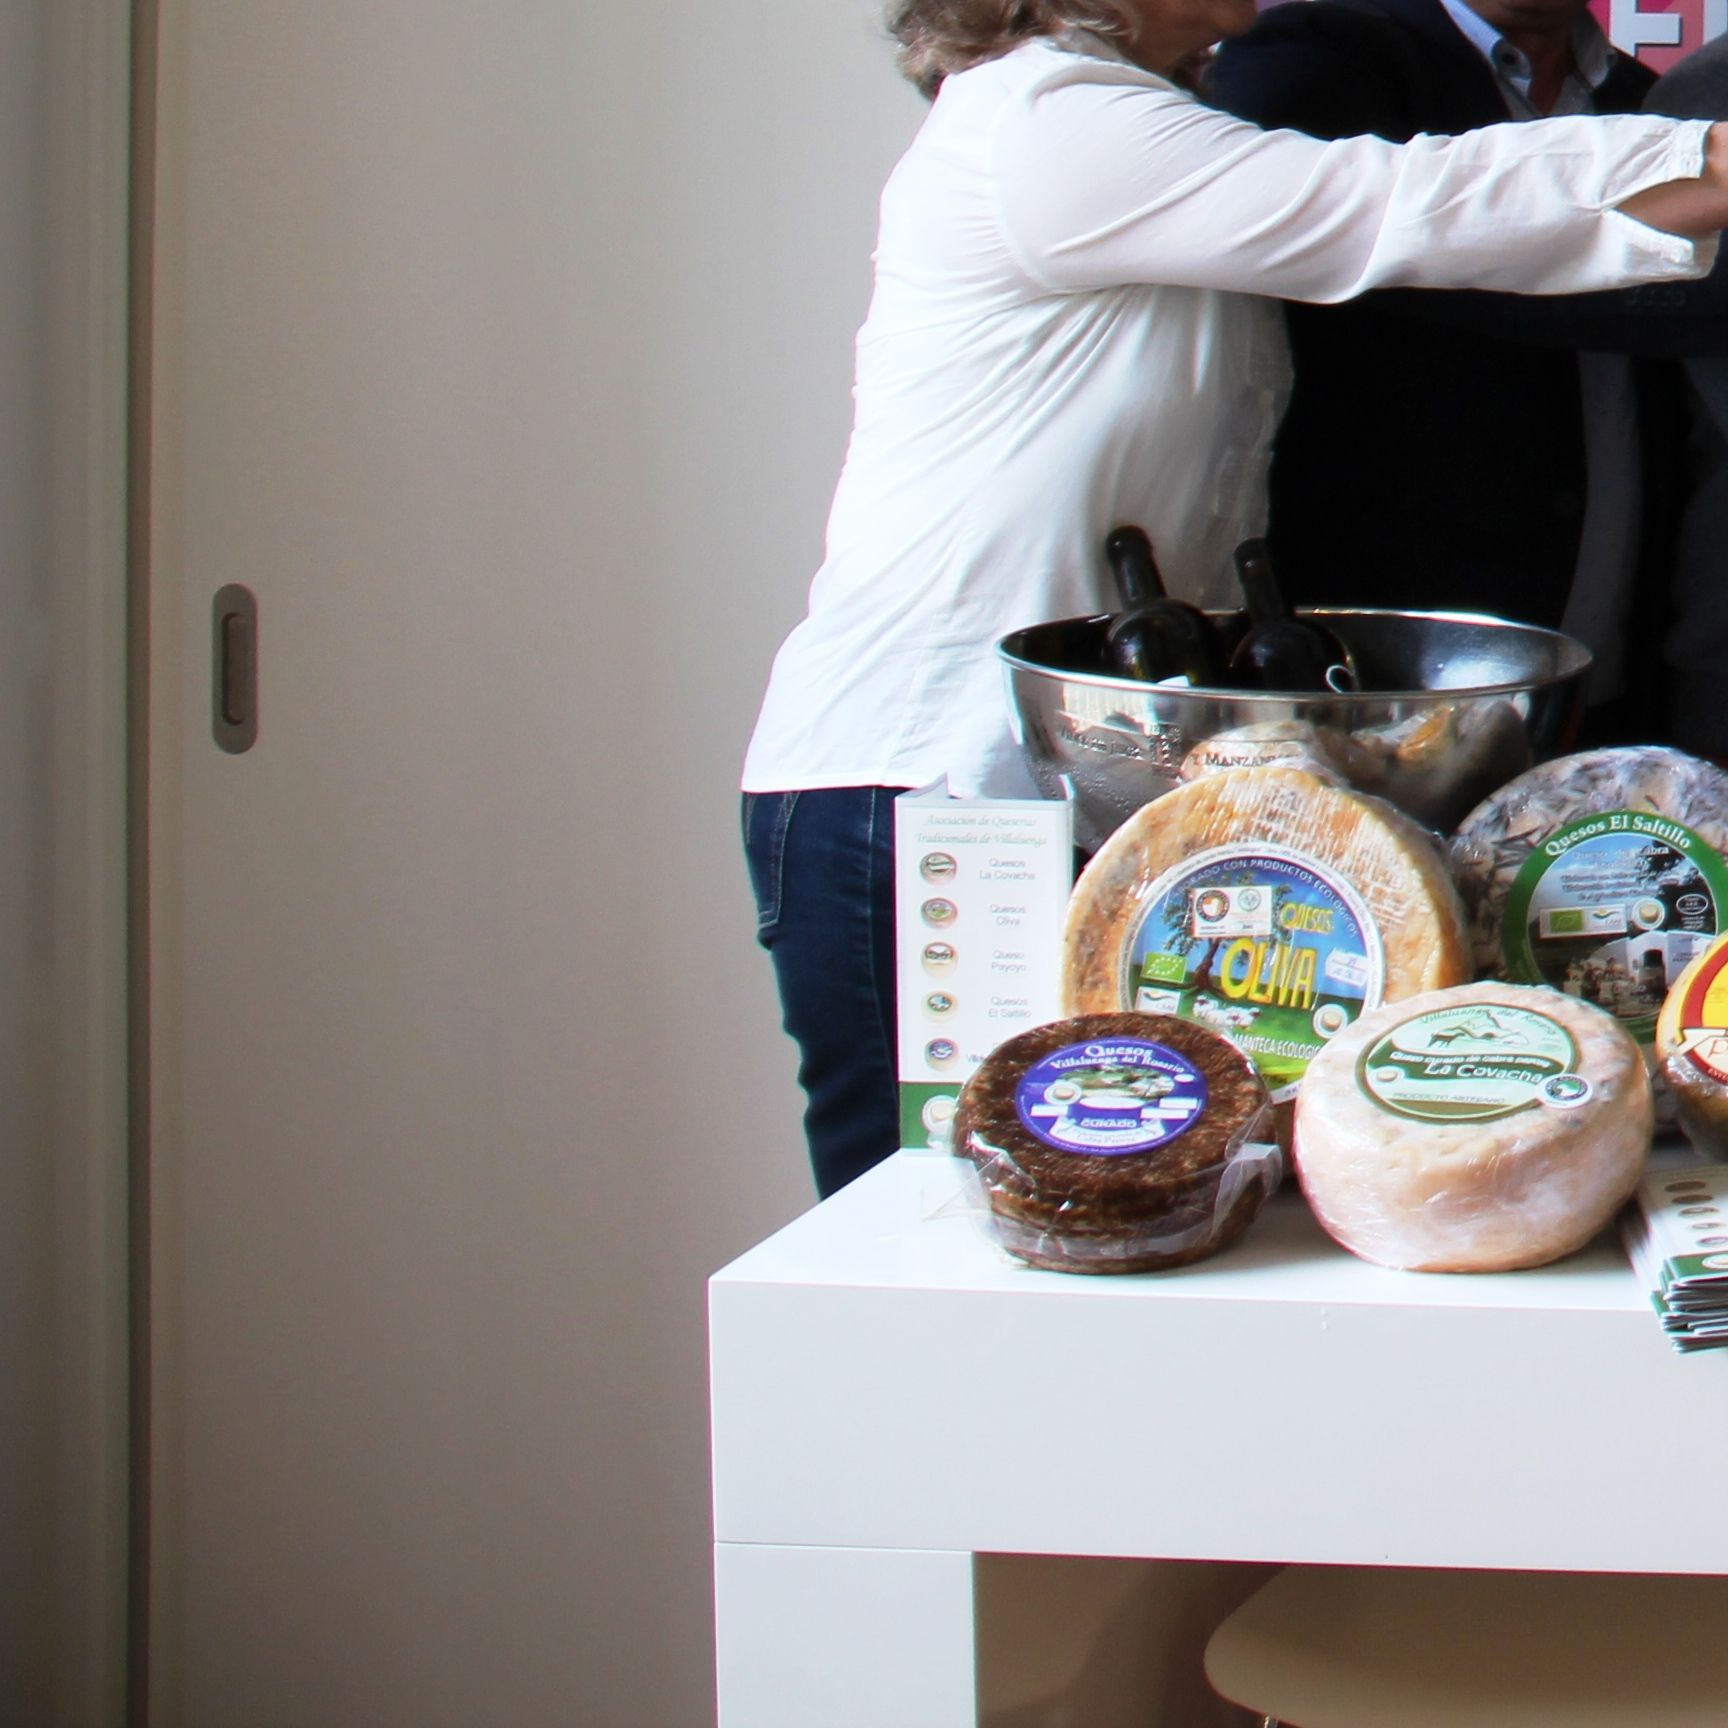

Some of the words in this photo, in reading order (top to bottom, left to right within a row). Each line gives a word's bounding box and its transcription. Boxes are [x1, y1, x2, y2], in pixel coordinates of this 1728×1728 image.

[1545, 819, 1605, 856] Quesos
[1608, 814, 1629, 831] El
[1632, 814, 1692, 850] Saltillo
[1223, 859, 1247, 871] CON
[1250, 858, 1313, 885] PRODUCTOS
[1220, 937, 1318, 1010] OLIVA
[1084, 1044, 1154, 1058] Quesos
[1276, 1039, 1321, 1060] ECOLOGIC
[1049, 1055, 1119, 1070] Villaluenga
[1121, 1055, 1138, 1065] del
[1140, 1055, 1185, 1073] Rosario
[1423, 1061, 1451, 1075] La
[1456, 1062, 1544, 1084] Covacha
